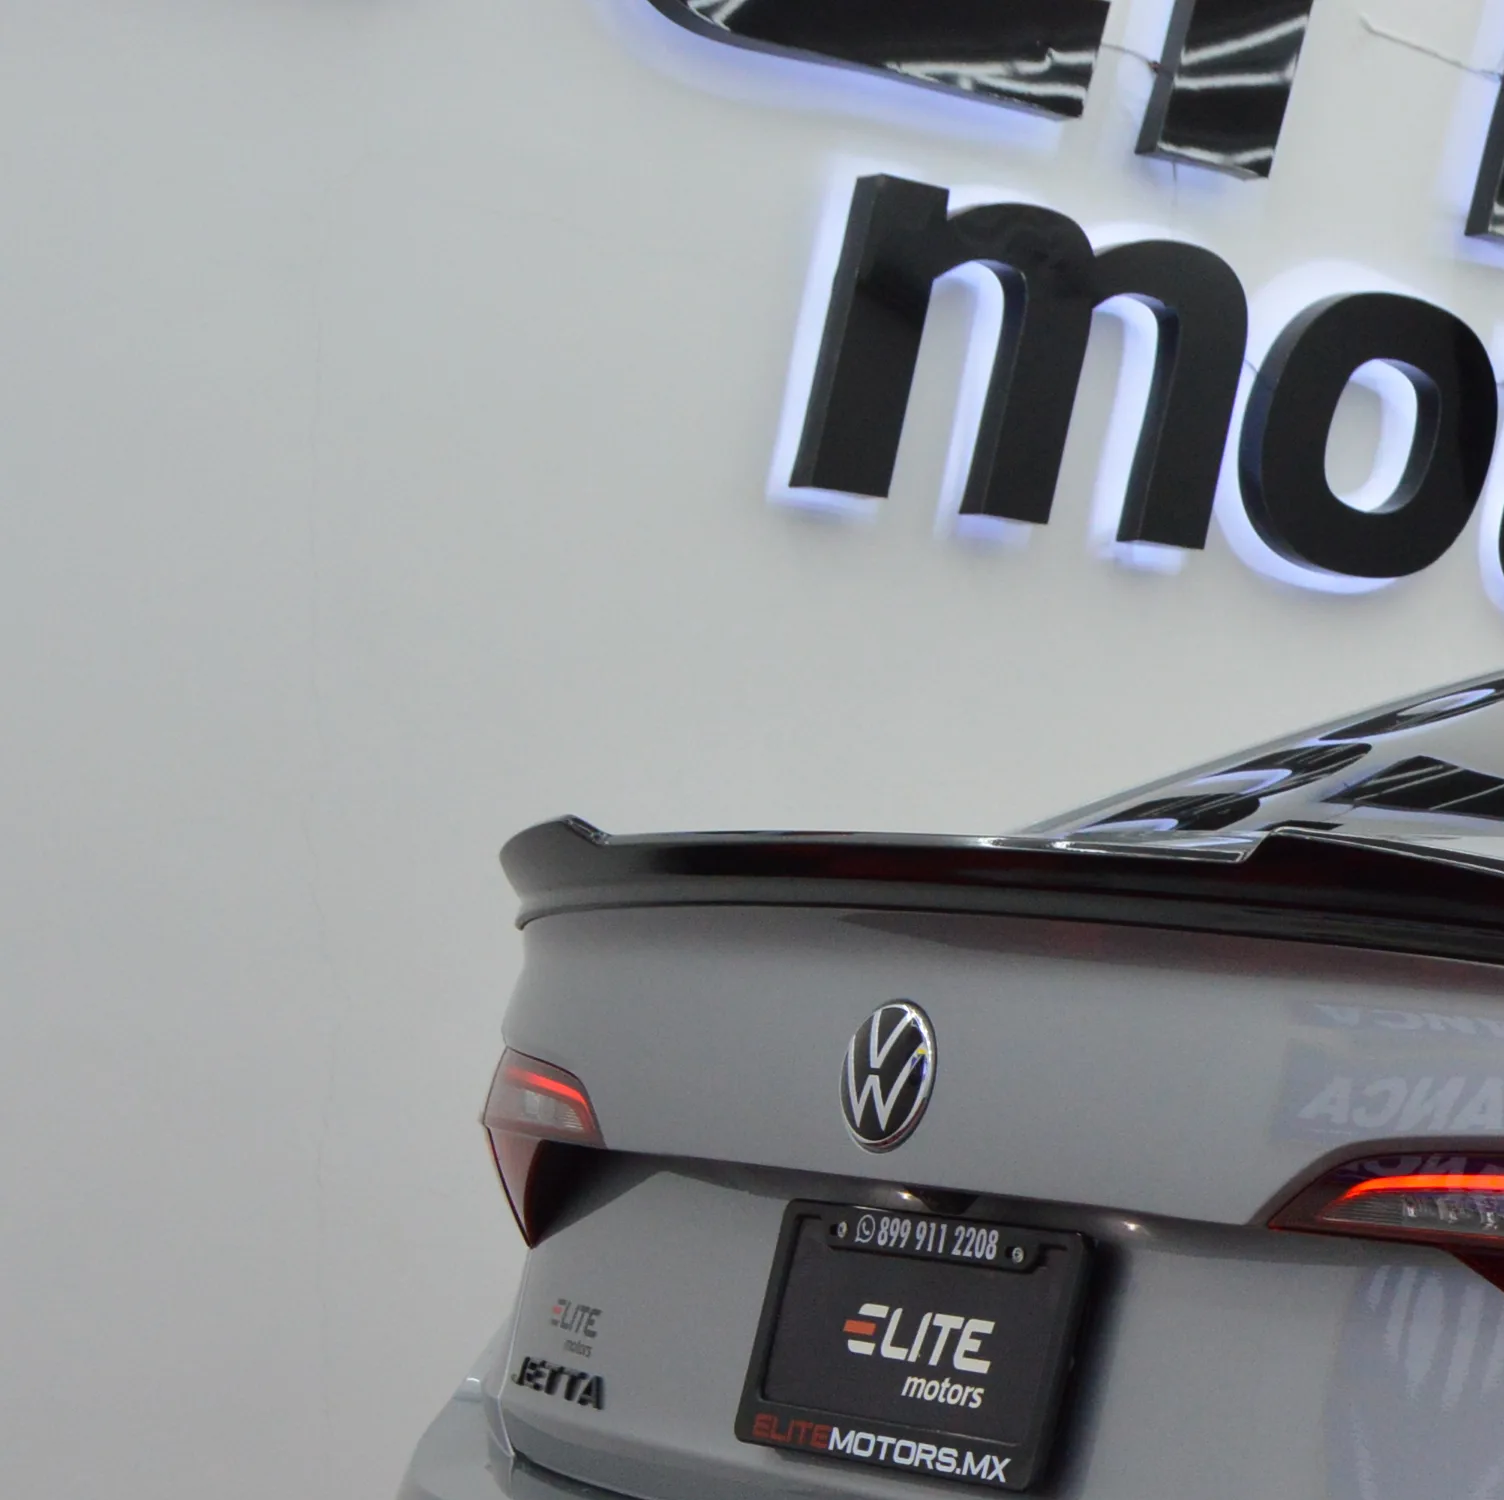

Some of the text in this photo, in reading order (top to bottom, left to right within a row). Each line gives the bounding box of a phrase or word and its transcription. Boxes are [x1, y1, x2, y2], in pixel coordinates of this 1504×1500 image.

[877, 1216, 999, 1260] 899 911 2208
[550, 1298, 603, 1339] ELITE
[843, 1303, 996, 1374] ELITE
[511, 1356, 605, 1410] JETTA
[901, 1375, 984, 1409] motors
[752, 1412, 1011, 1483] ELITEMOTORS.MX
